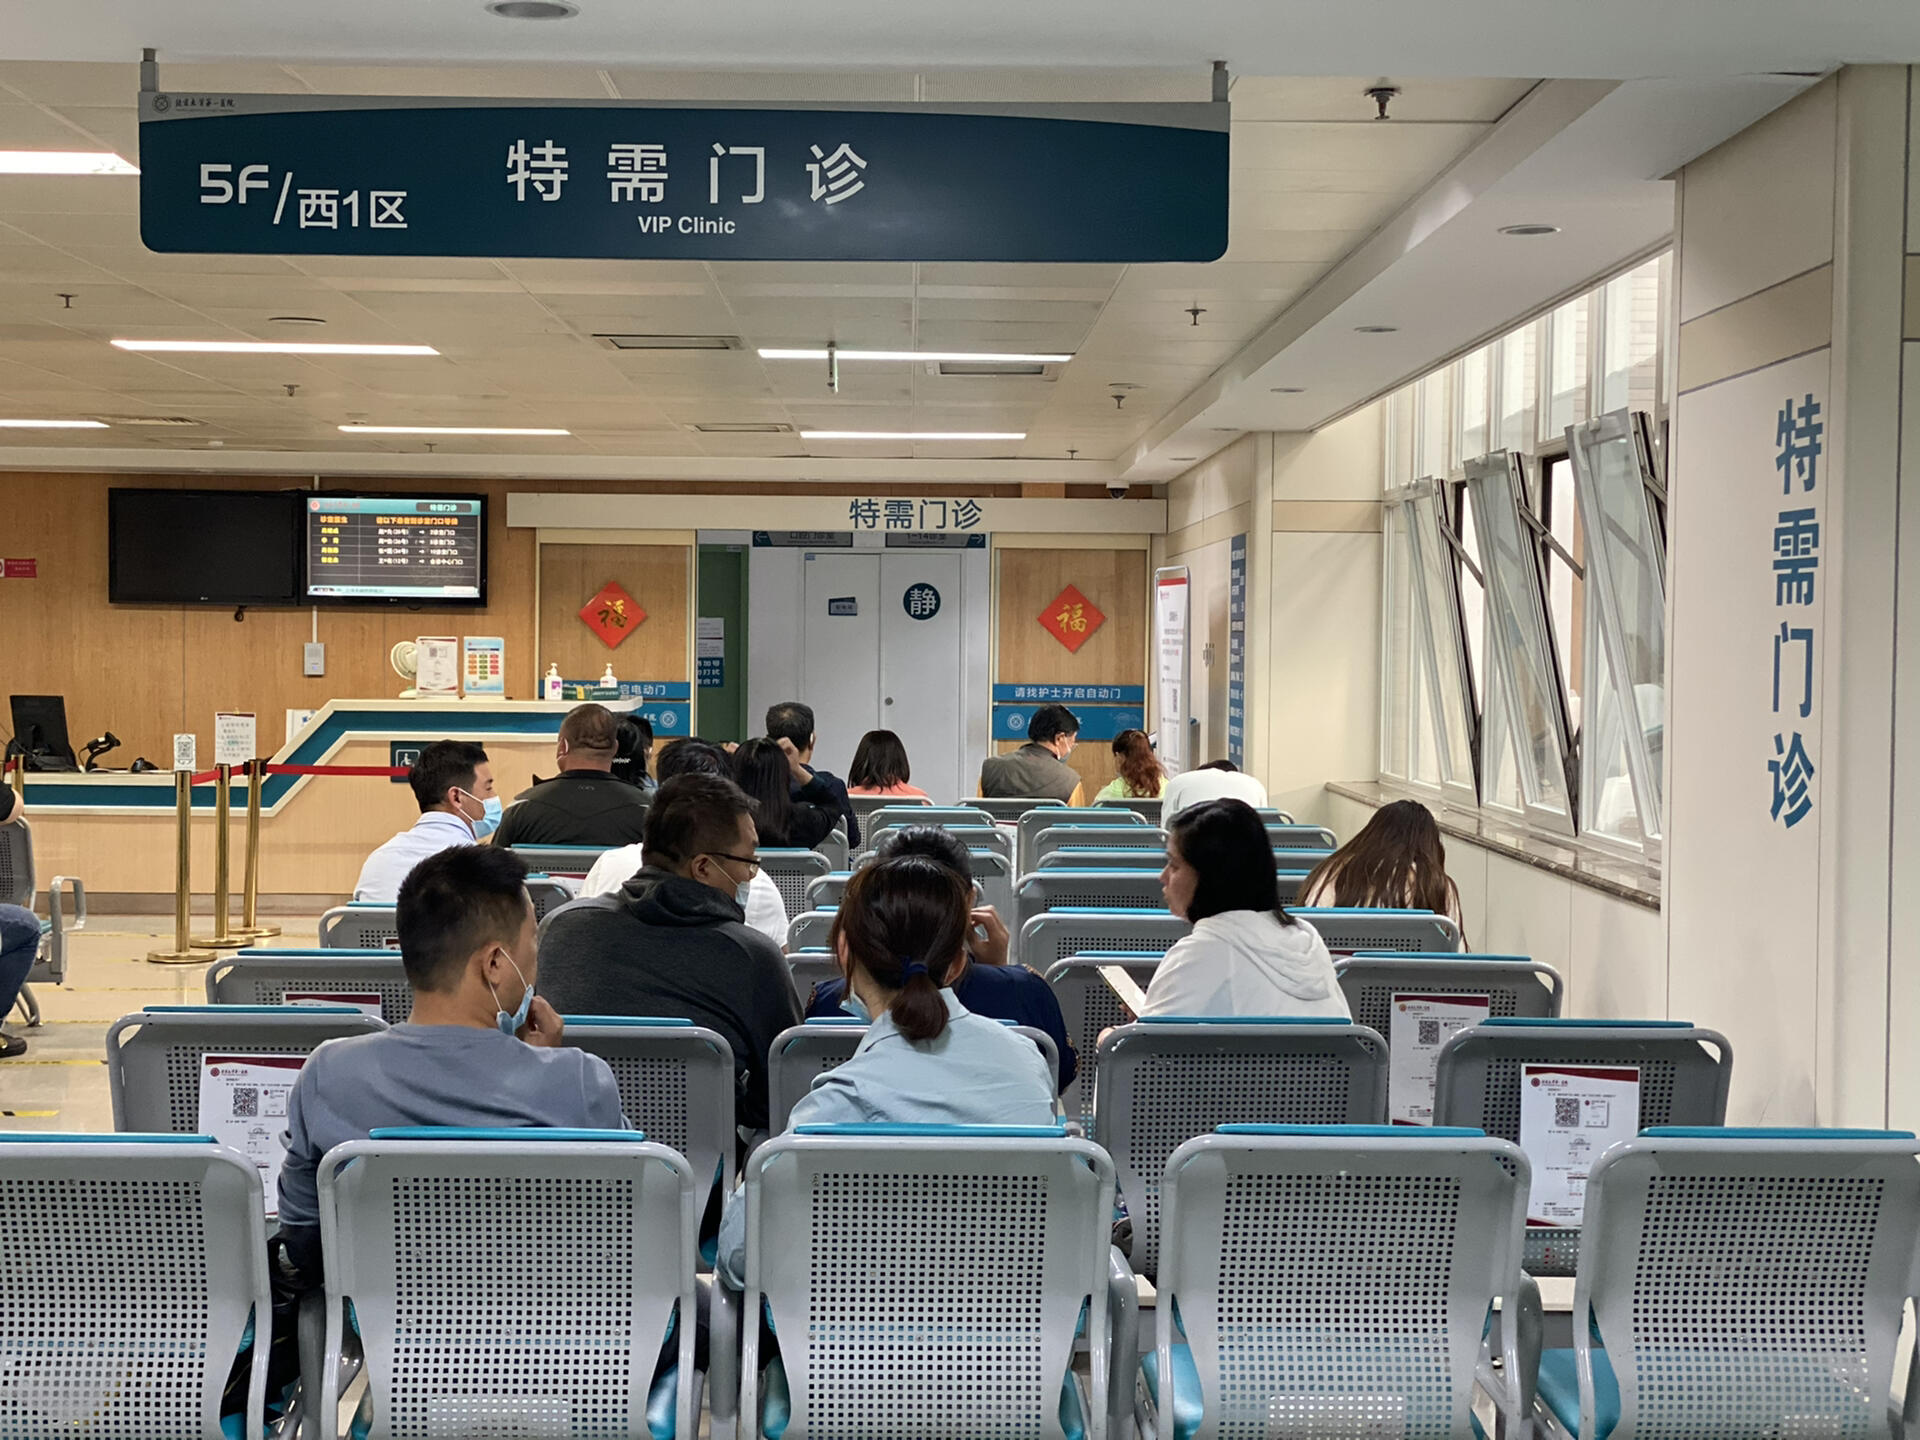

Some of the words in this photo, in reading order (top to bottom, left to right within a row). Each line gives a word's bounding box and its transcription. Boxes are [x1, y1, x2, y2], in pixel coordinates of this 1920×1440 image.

[506, 139, 868, 205] 特需门诊
[638, 216, 672, 233] VIP
[677, 216, 736, 234] Clinic
[849, 498, 983, 529] 特需门诊
[597, 600, 628, 629] 福
[910, 588, 937, 615] 静
[1767, 393, 1824, 829] 特需门诊
[1056, 603, 1088, 633] 福
[1014, 686, 1121, 699] 请找护士开启自动门
